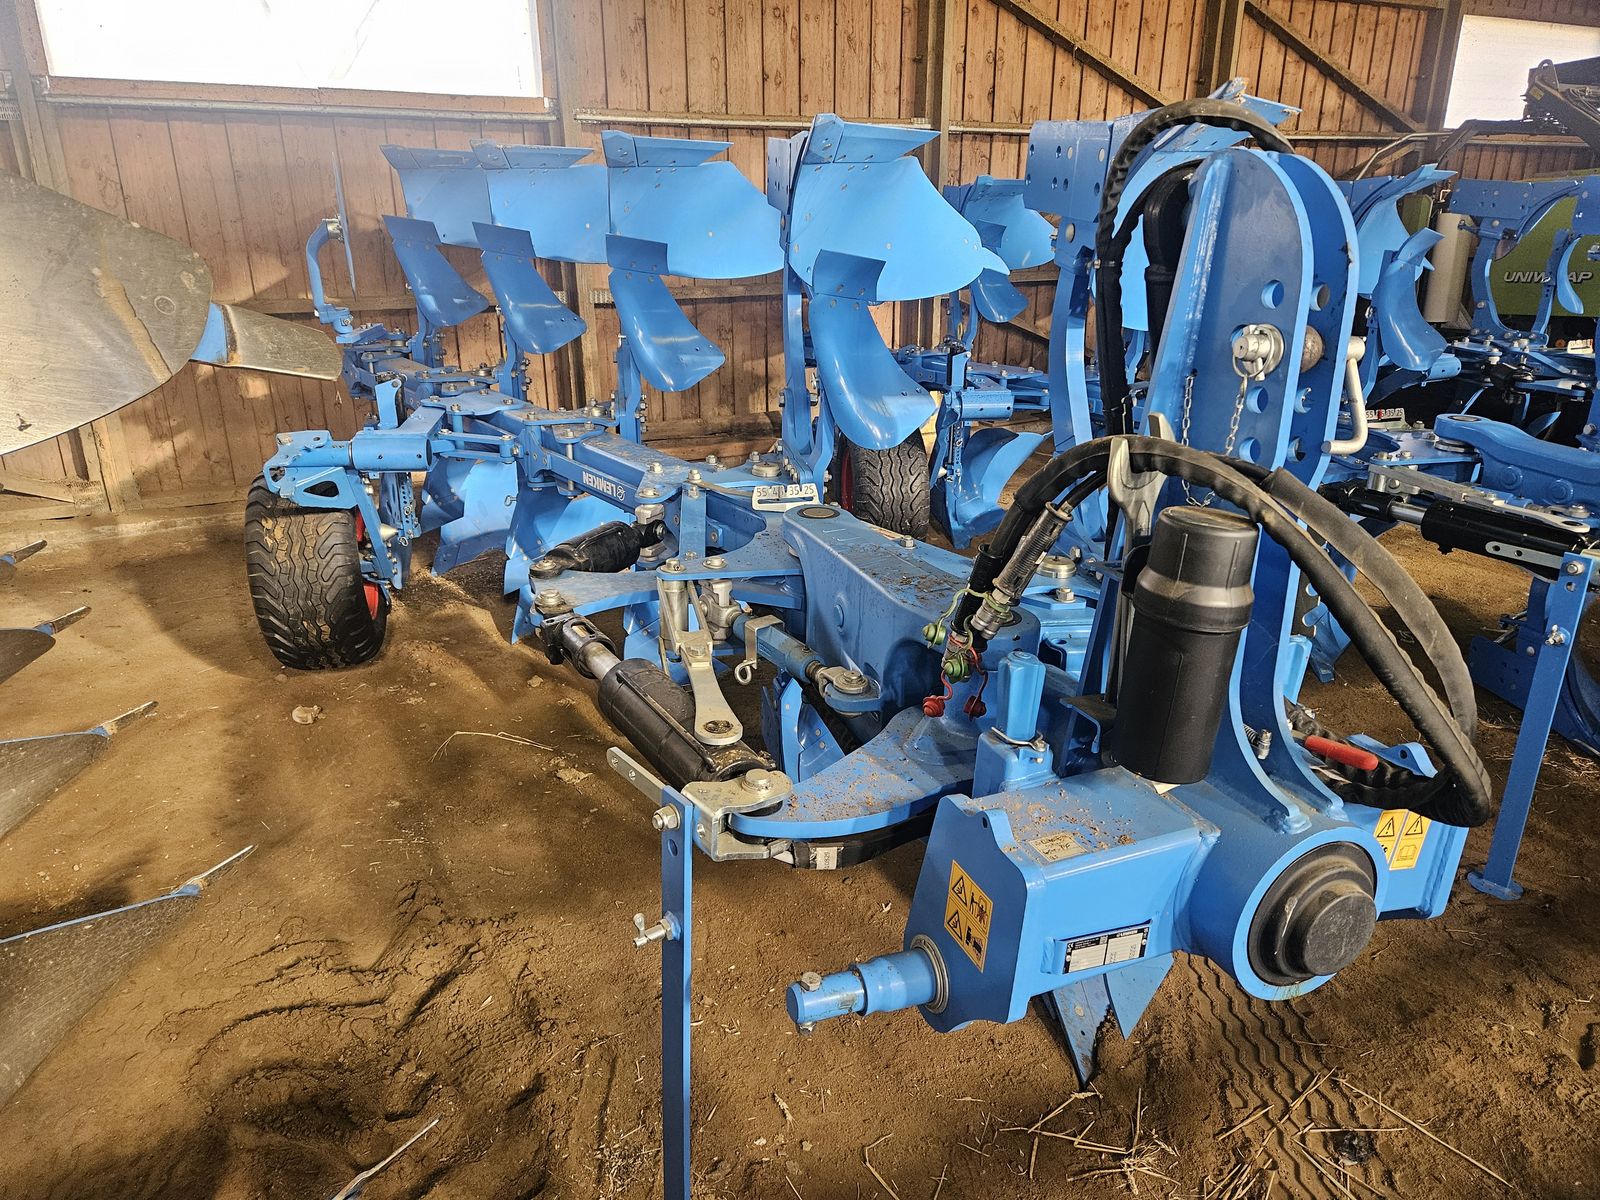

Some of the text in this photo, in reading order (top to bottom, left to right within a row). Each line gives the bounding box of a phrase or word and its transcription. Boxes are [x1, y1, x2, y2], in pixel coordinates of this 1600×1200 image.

[1503, 271, 1592, 283] UNIWAP
[583, 471, 616, 497] LEMKEN
[756, 487, 767, 497] 55
[789, 486, 799, 495] 35
[804, 485, 814, 494] 25
